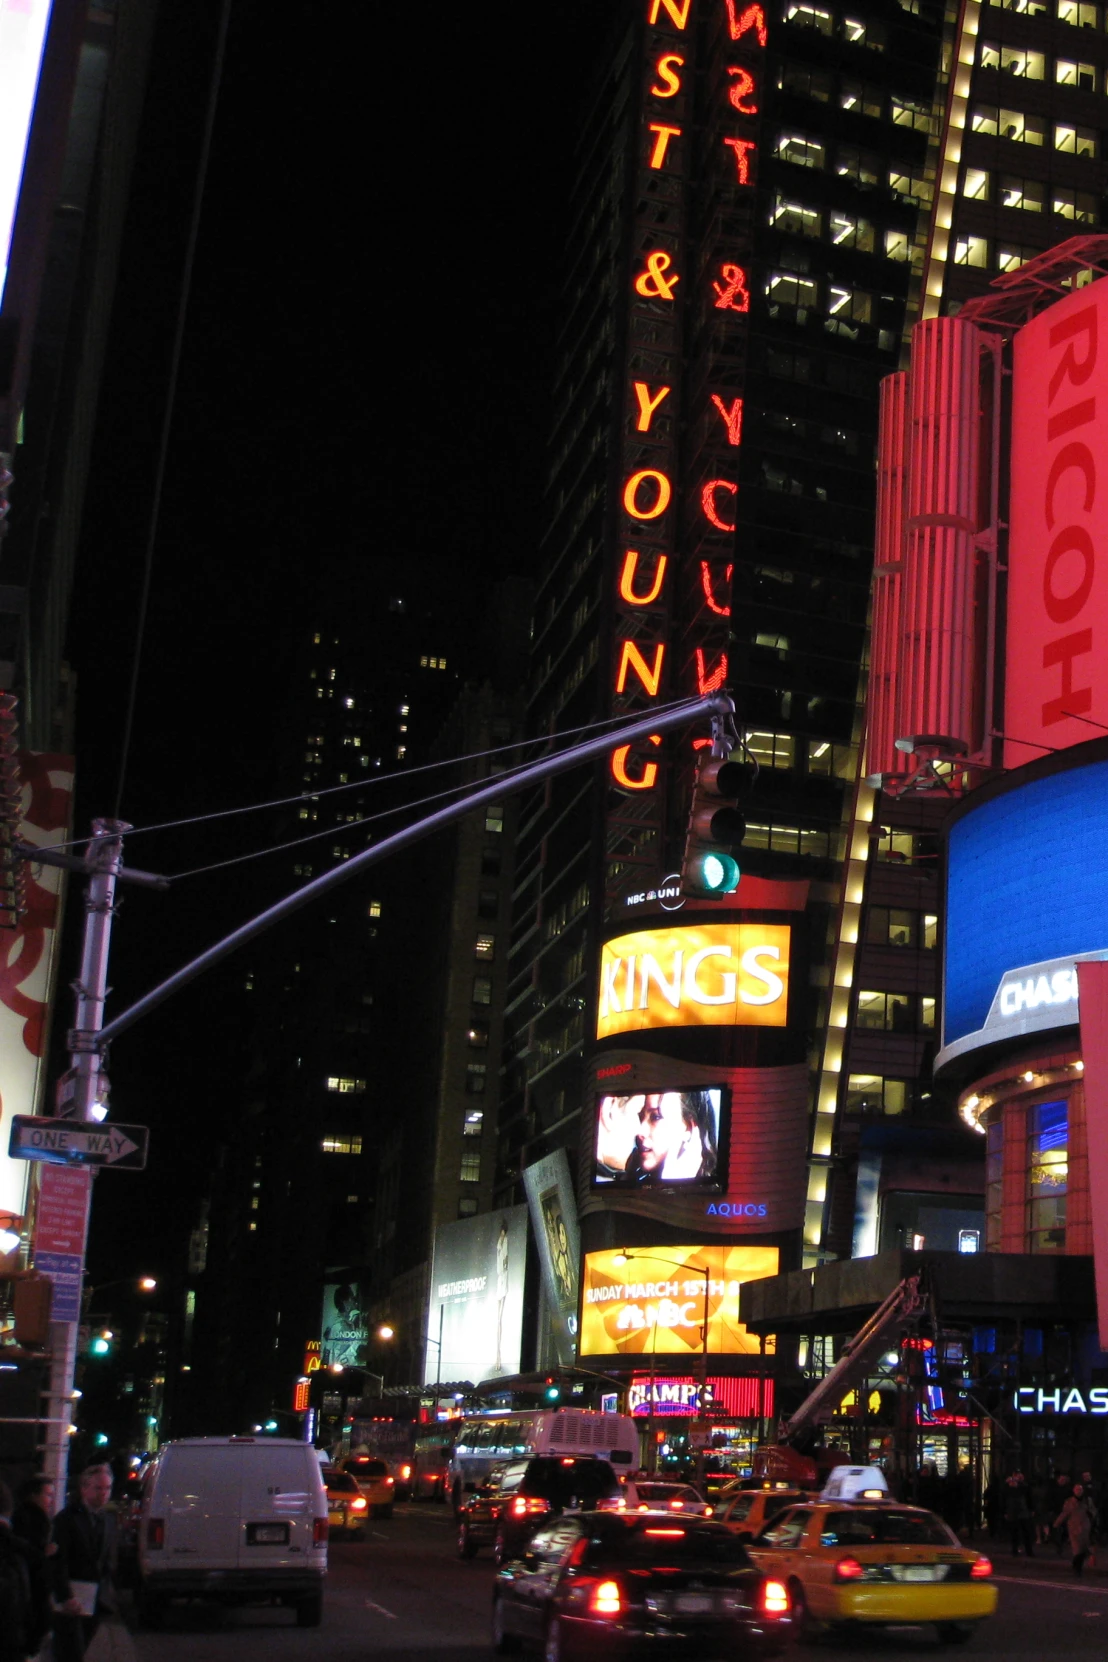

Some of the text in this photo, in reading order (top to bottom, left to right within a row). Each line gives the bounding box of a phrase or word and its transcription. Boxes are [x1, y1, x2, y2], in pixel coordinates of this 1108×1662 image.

[1042, 303, 1098, 727] RICOH
[611, 381, 672, 790] YOUNG
[627, 892, 645, 906] NBC
[600, 944, 784, 1020] KINGS
[597, 1063, 632, 1079] SHARP
[31, 1130, 126, 1154] ONE WAY
[707, 1203, 767, 1217] AQUOS
[438, 1276, 487, 1298] WEATHERPROOF
[586, 1284, 623, 1304] SUNDAY
[625, 1281, 679, 1299] MARCH
[682, 1280, 724, 1297] 15TH
